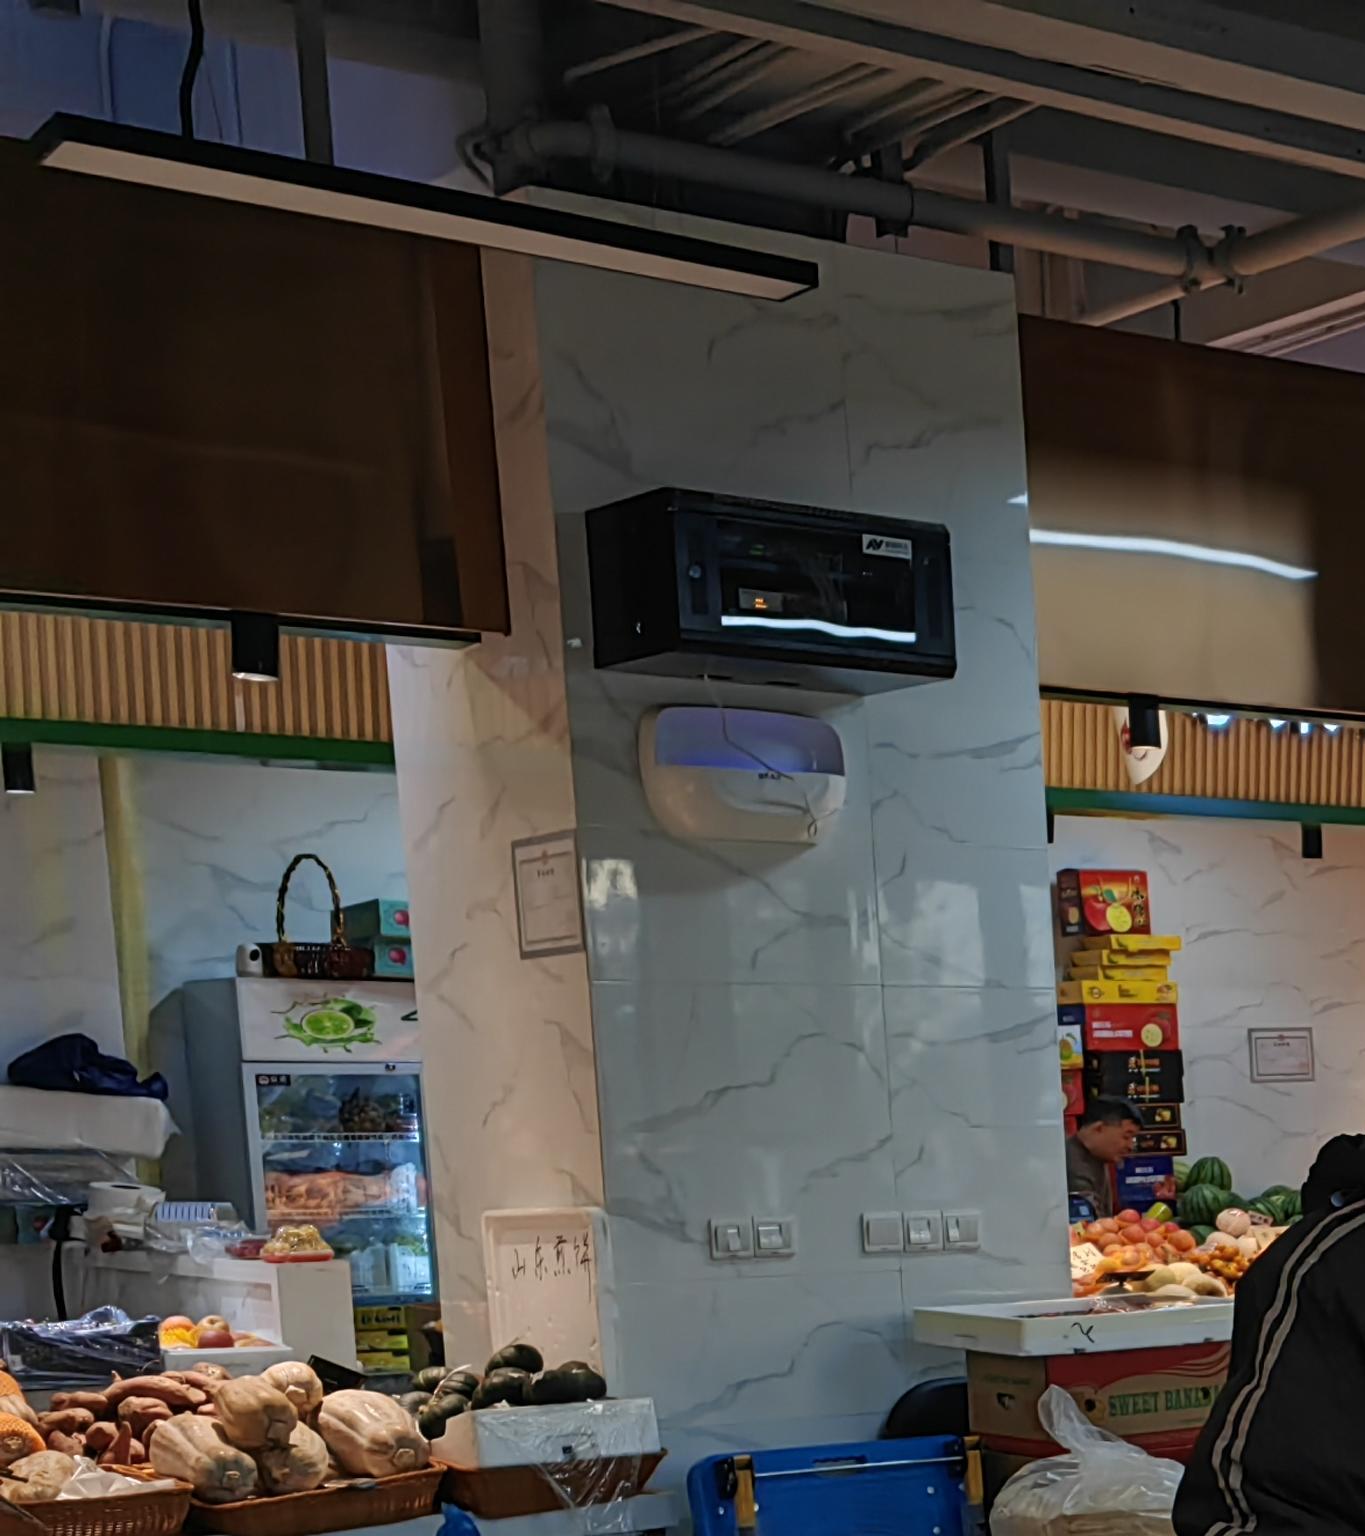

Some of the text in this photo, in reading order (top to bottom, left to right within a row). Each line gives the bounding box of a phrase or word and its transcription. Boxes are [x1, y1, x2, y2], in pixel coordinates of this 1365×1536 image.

[511, 1231, 592, 1304] 山东煎饼
[1109, 1391, 1159, 1416] SWEET
